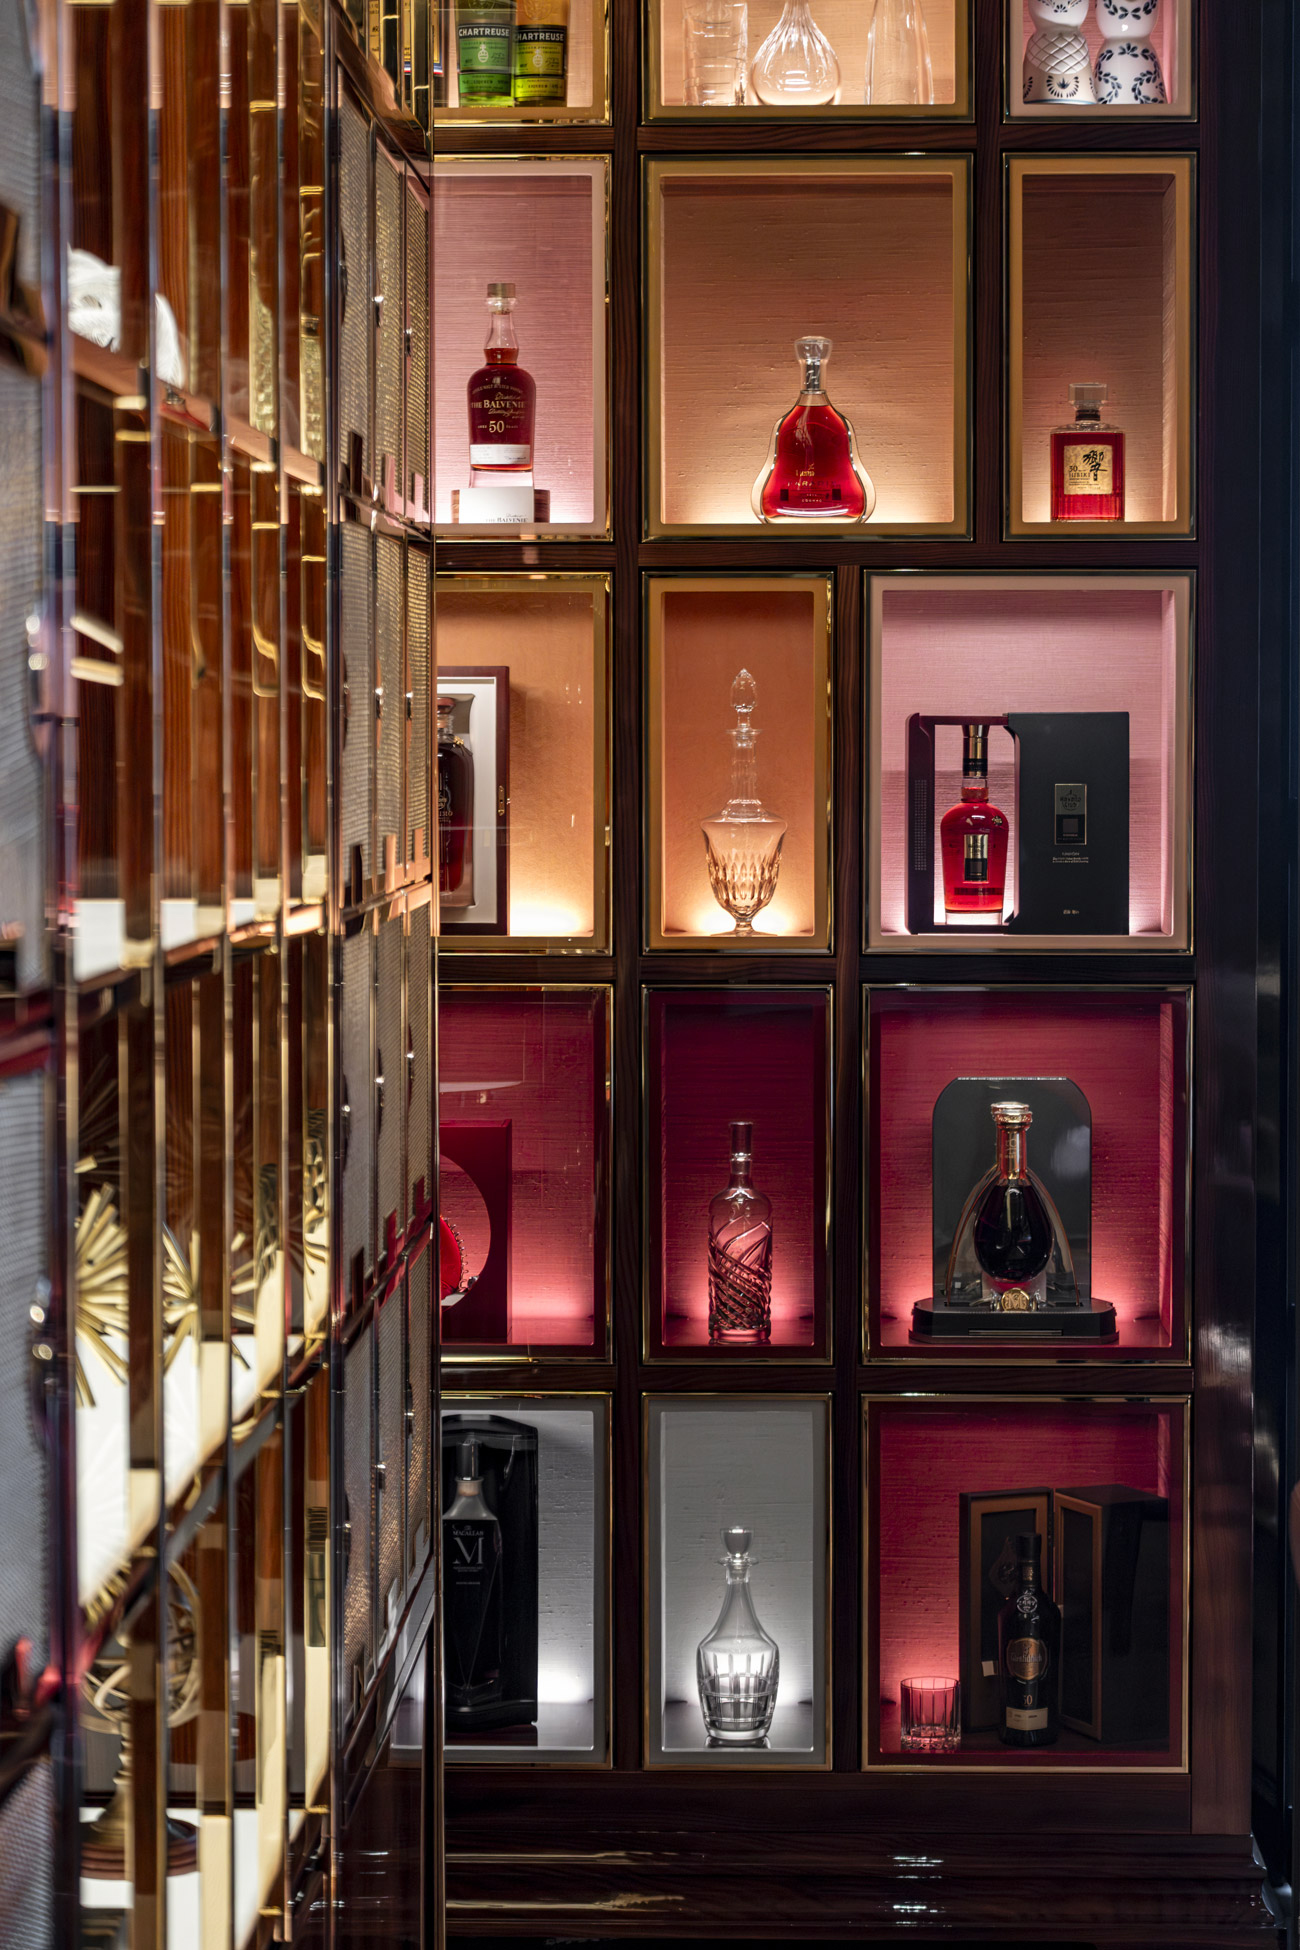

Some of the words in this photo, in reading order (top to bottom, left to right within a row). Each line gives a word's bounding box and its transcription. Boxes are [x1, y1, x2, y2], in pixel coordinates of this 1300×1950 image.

[458, 28, 510, 37] CHARTREUSE
[483, 400, 525, 408] BALVENIE
[489, 420, 505, 433] 50
